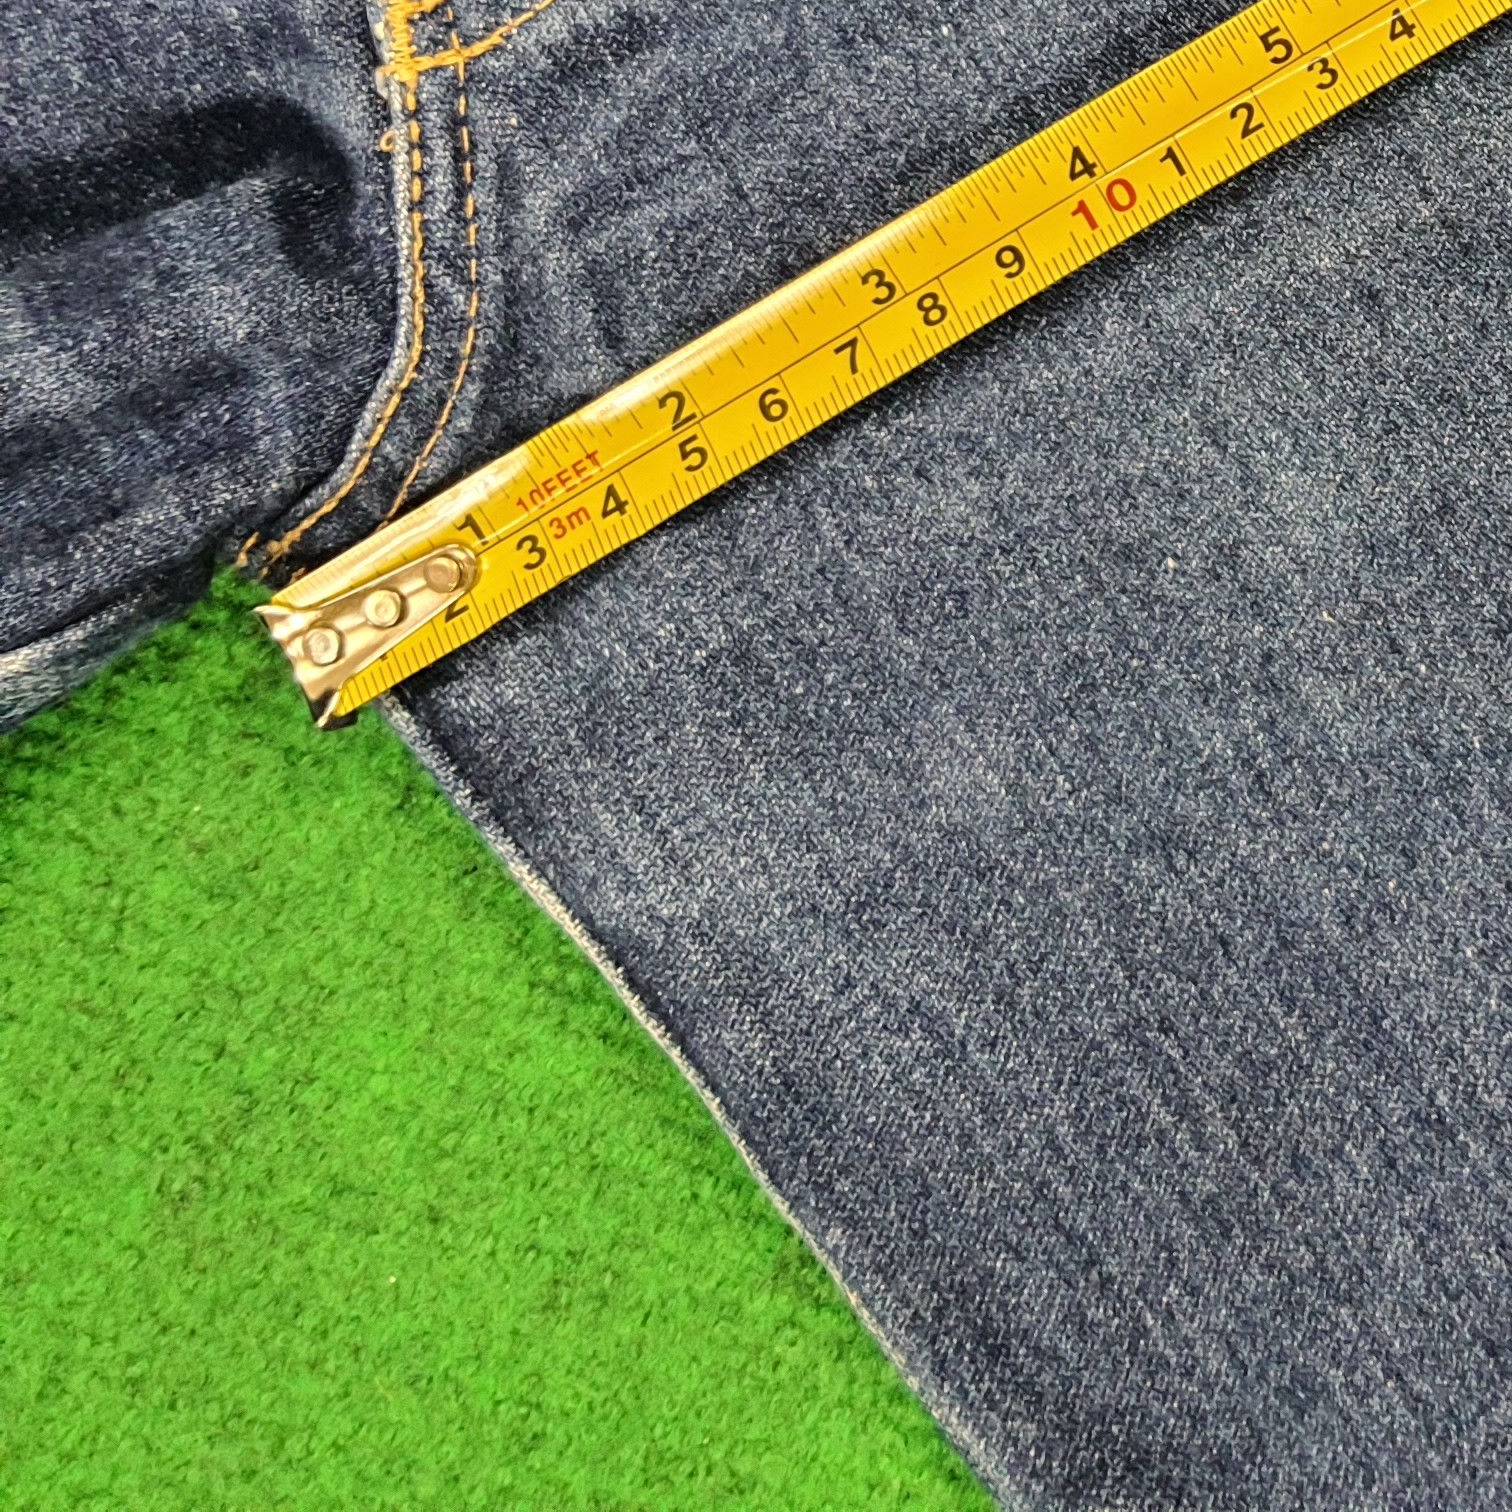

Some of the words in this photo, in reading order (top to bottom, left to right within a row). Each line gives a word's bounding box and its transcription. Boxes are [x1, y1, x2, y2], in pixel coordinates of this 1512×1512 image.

[456, 513, 489, 546] 1
[658, 391, 697, 431] 2
[861, 268, 896, 305] 3
[1068, 145, 1097, 182] 4
[1259, 26, 1294, 65] 5
[516, 534, 548, 571] 3
[601, 483, 630, 520] 4
[678, 433, 708, 472] 5
[758, 387, 789, 423] 6
[833, 337, 862, 375] 7
[916, 292, 948, 327] 8
[995, 245, 1026, 279] 9
[1070, 177, 1138, 232] 10
[1158, 145, 1187, 178] 1
[1230, 101, 1265, 140] 2
[1306, 56, 1340, 91] 3
[1387, 7, 1416, 45] 4
[549, 506, 591, 540] 3m
